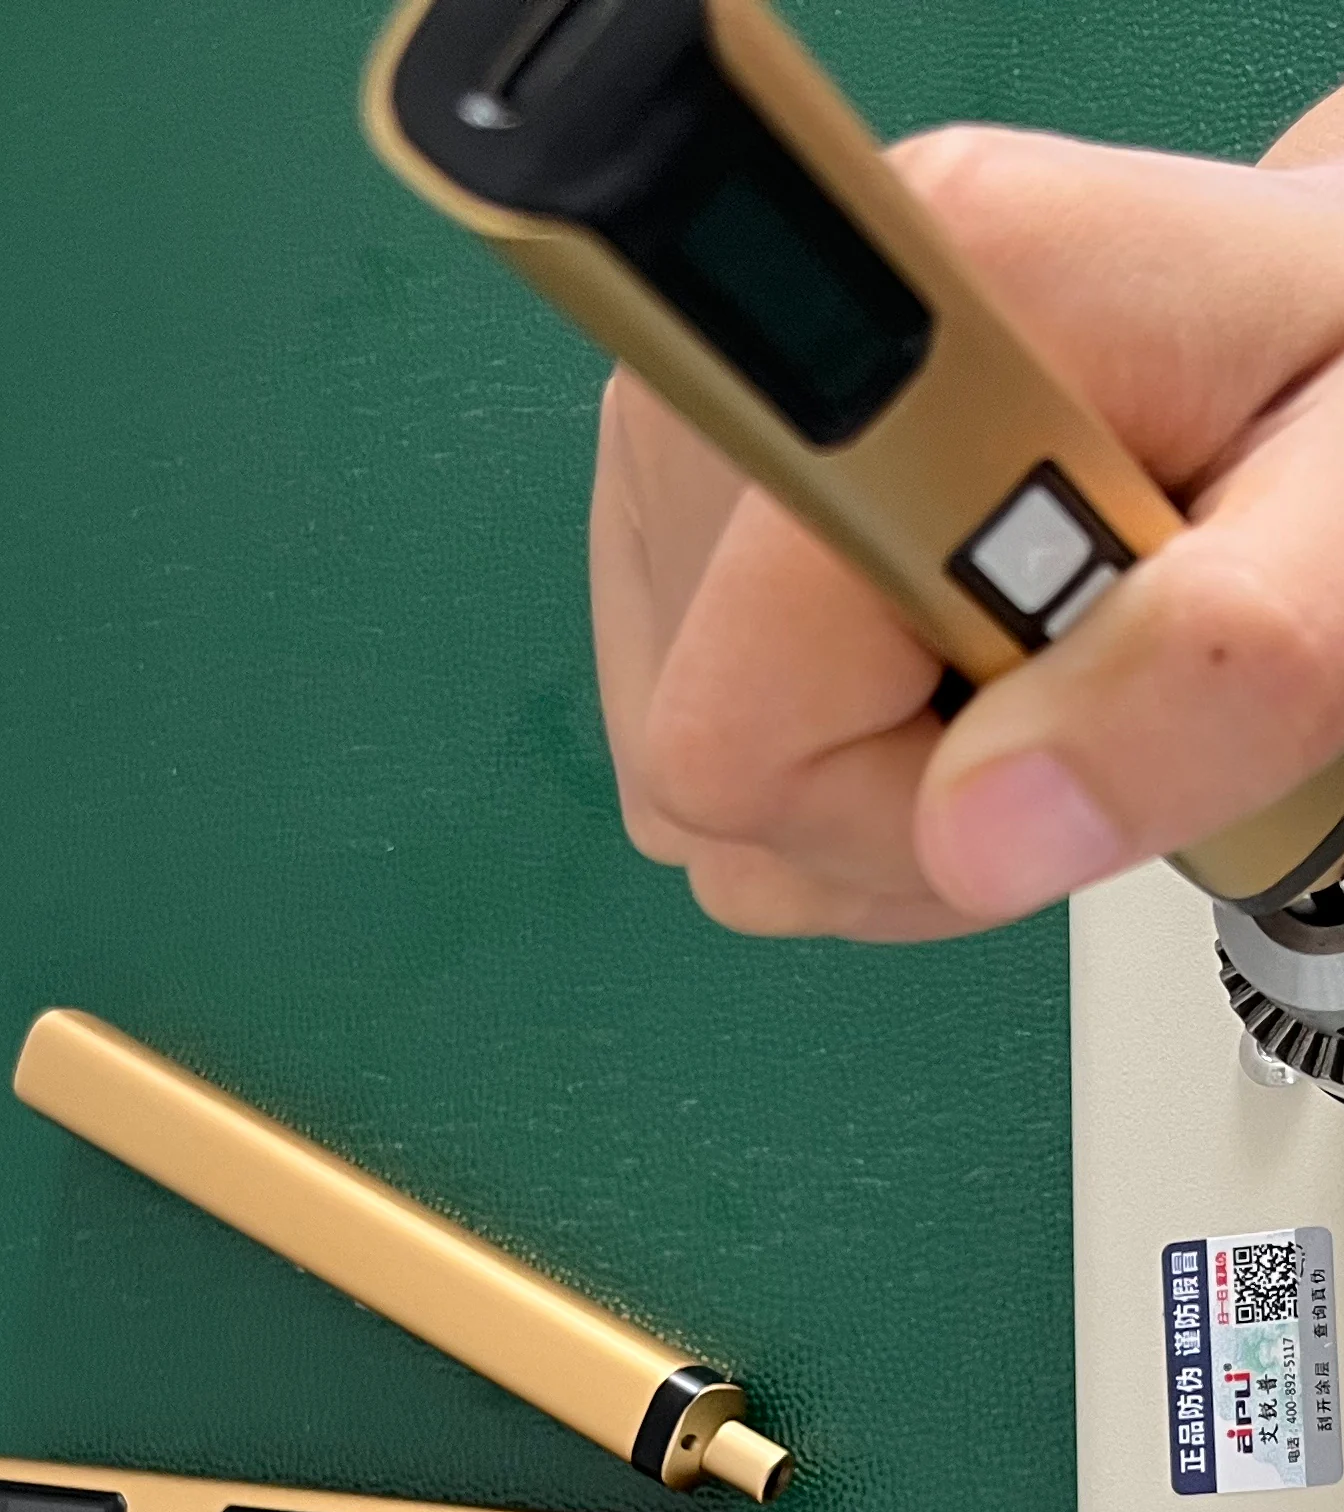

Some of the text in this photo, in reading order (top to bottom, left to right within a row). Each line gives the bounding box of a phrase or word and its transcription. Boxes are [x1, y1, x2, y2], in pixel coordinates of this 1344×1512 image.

[1171, 1251, 1206, 1473] 正品防伪 谨防假冒
[1257, 1374, 1278, 1444] 艾锐普
[1283, 1337, 1296, 1424] 400-892-5117
[1310, 1269, 1333, 1431] 刮开涂层 查询真伪
